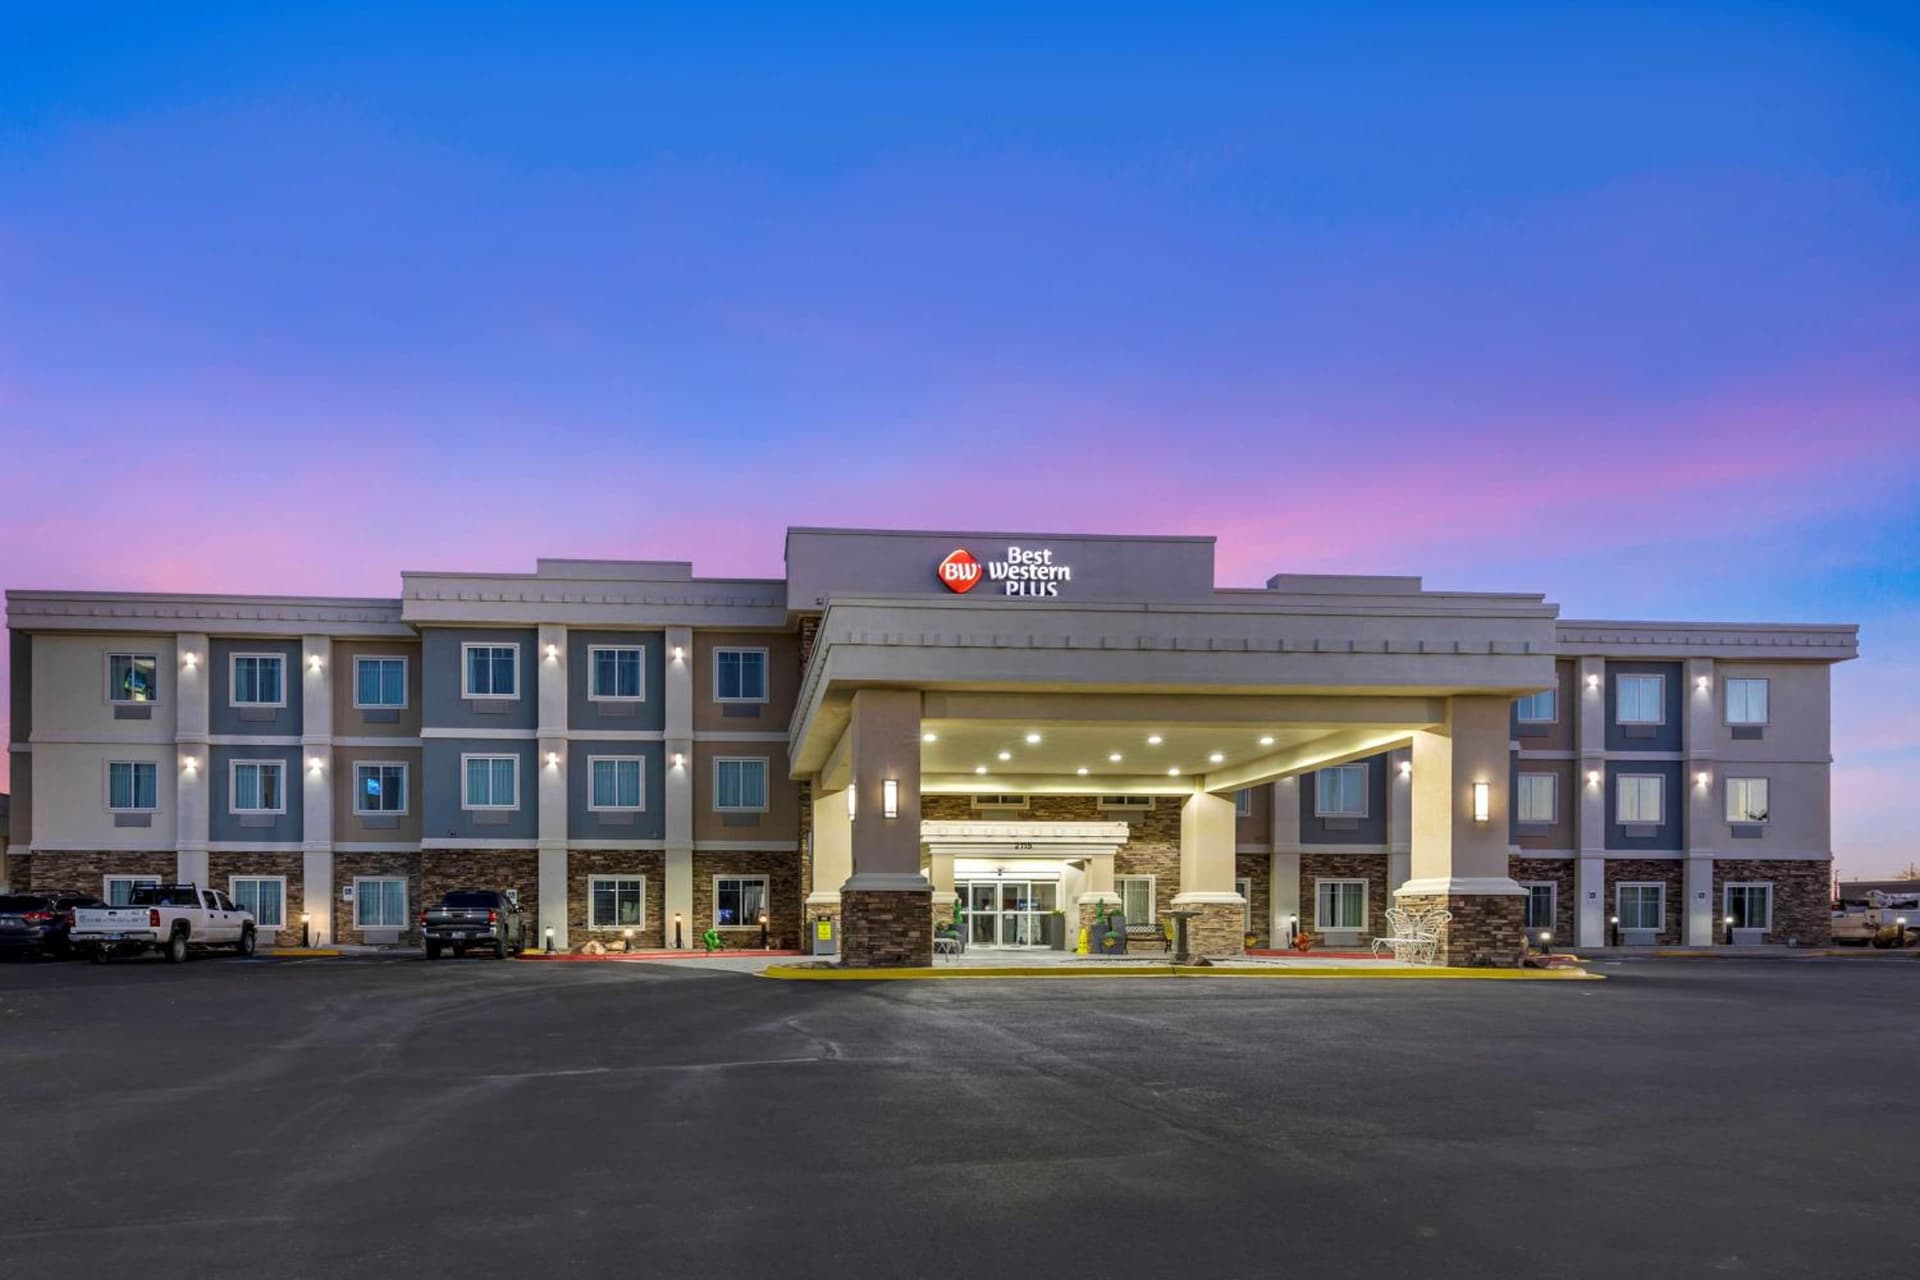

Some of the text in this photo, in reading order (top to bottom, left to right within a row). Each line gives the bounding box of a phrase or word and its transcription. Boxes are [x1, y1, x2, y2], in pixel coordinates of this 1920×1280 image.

[1008, 546, 1052, 565] Best
[945, 563, 977, 580] BW
[988, 562, 1071, 580] Western
[1005, 581, 1058, 597] PLUS
